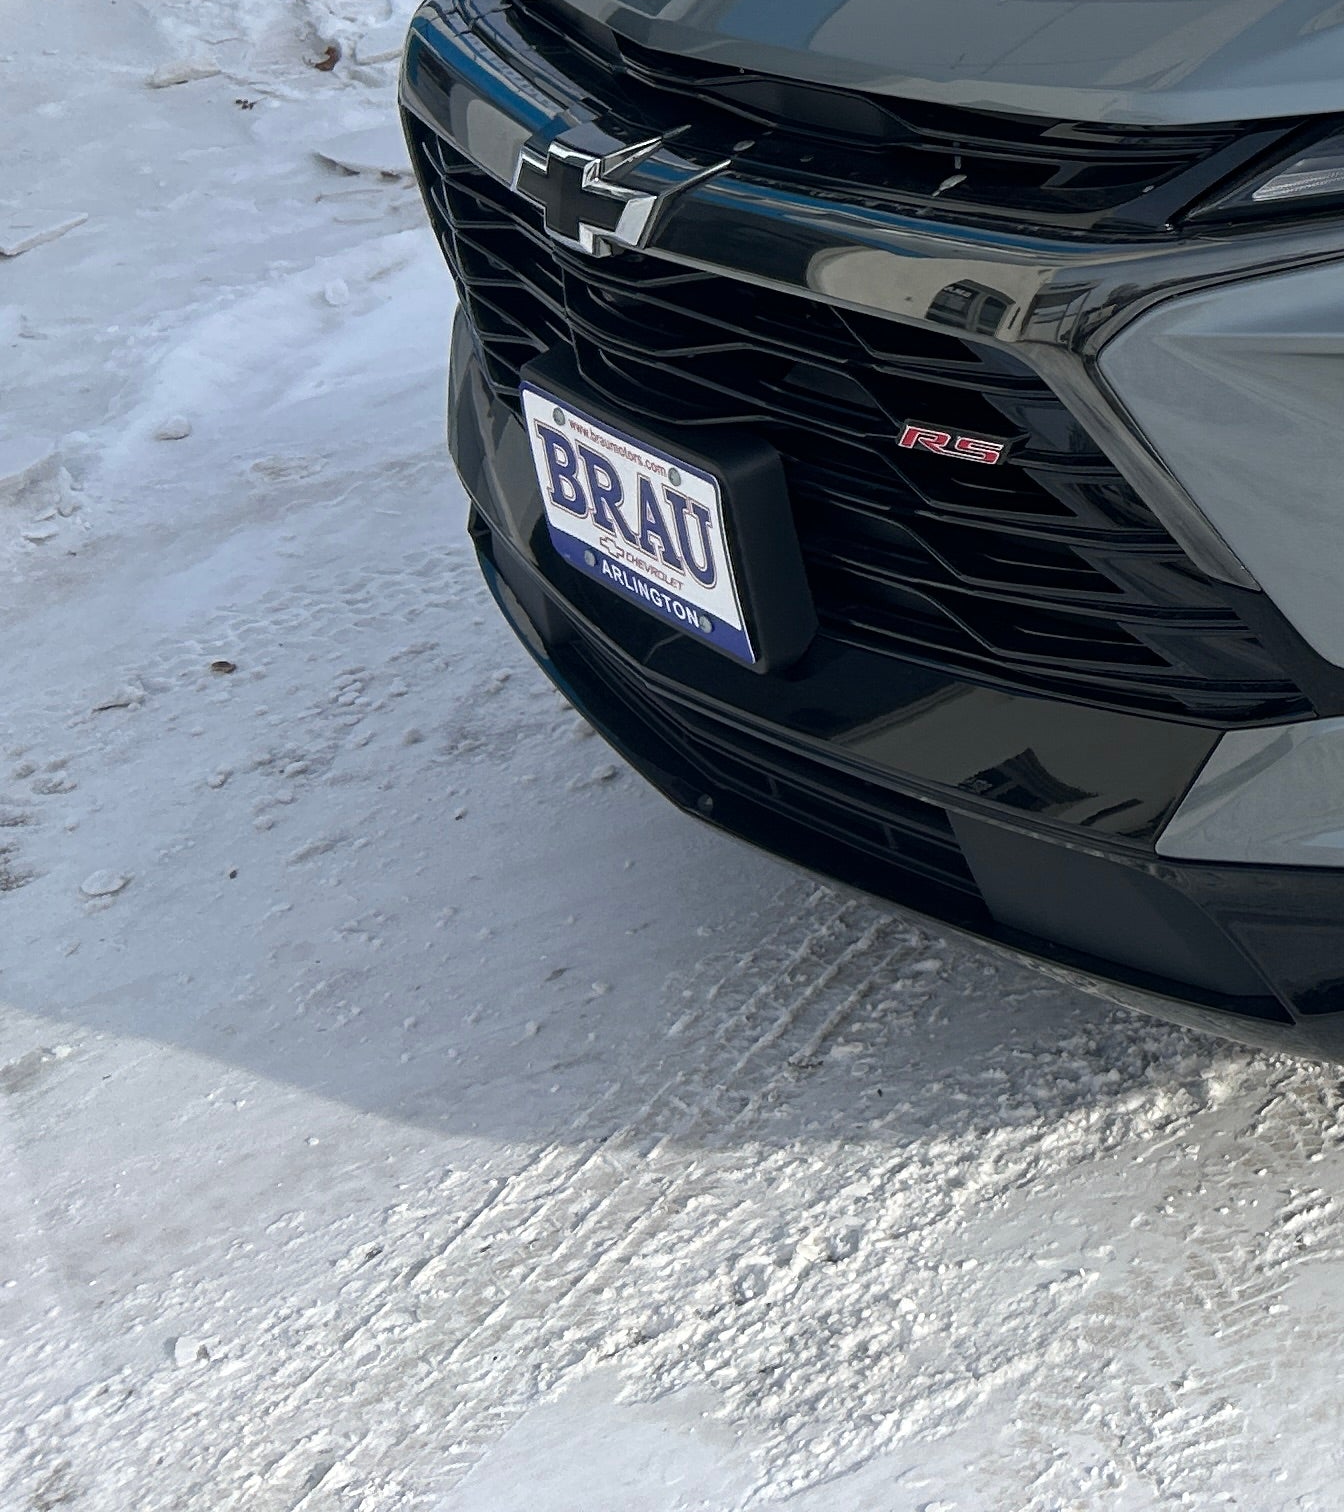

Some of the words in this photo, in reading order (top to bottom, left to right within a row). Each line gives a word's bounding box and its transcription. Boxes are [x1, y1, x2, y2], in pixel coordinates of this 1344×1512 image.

[568, 418, 668, 478] www.braumotors.com
[899, 425, 1004, 465] RS
[533, 419, 717, 590] BRAU
[602, 559, 700, 629] ARLINGTON
[626, 552, 684, 591] CHEVROLET
